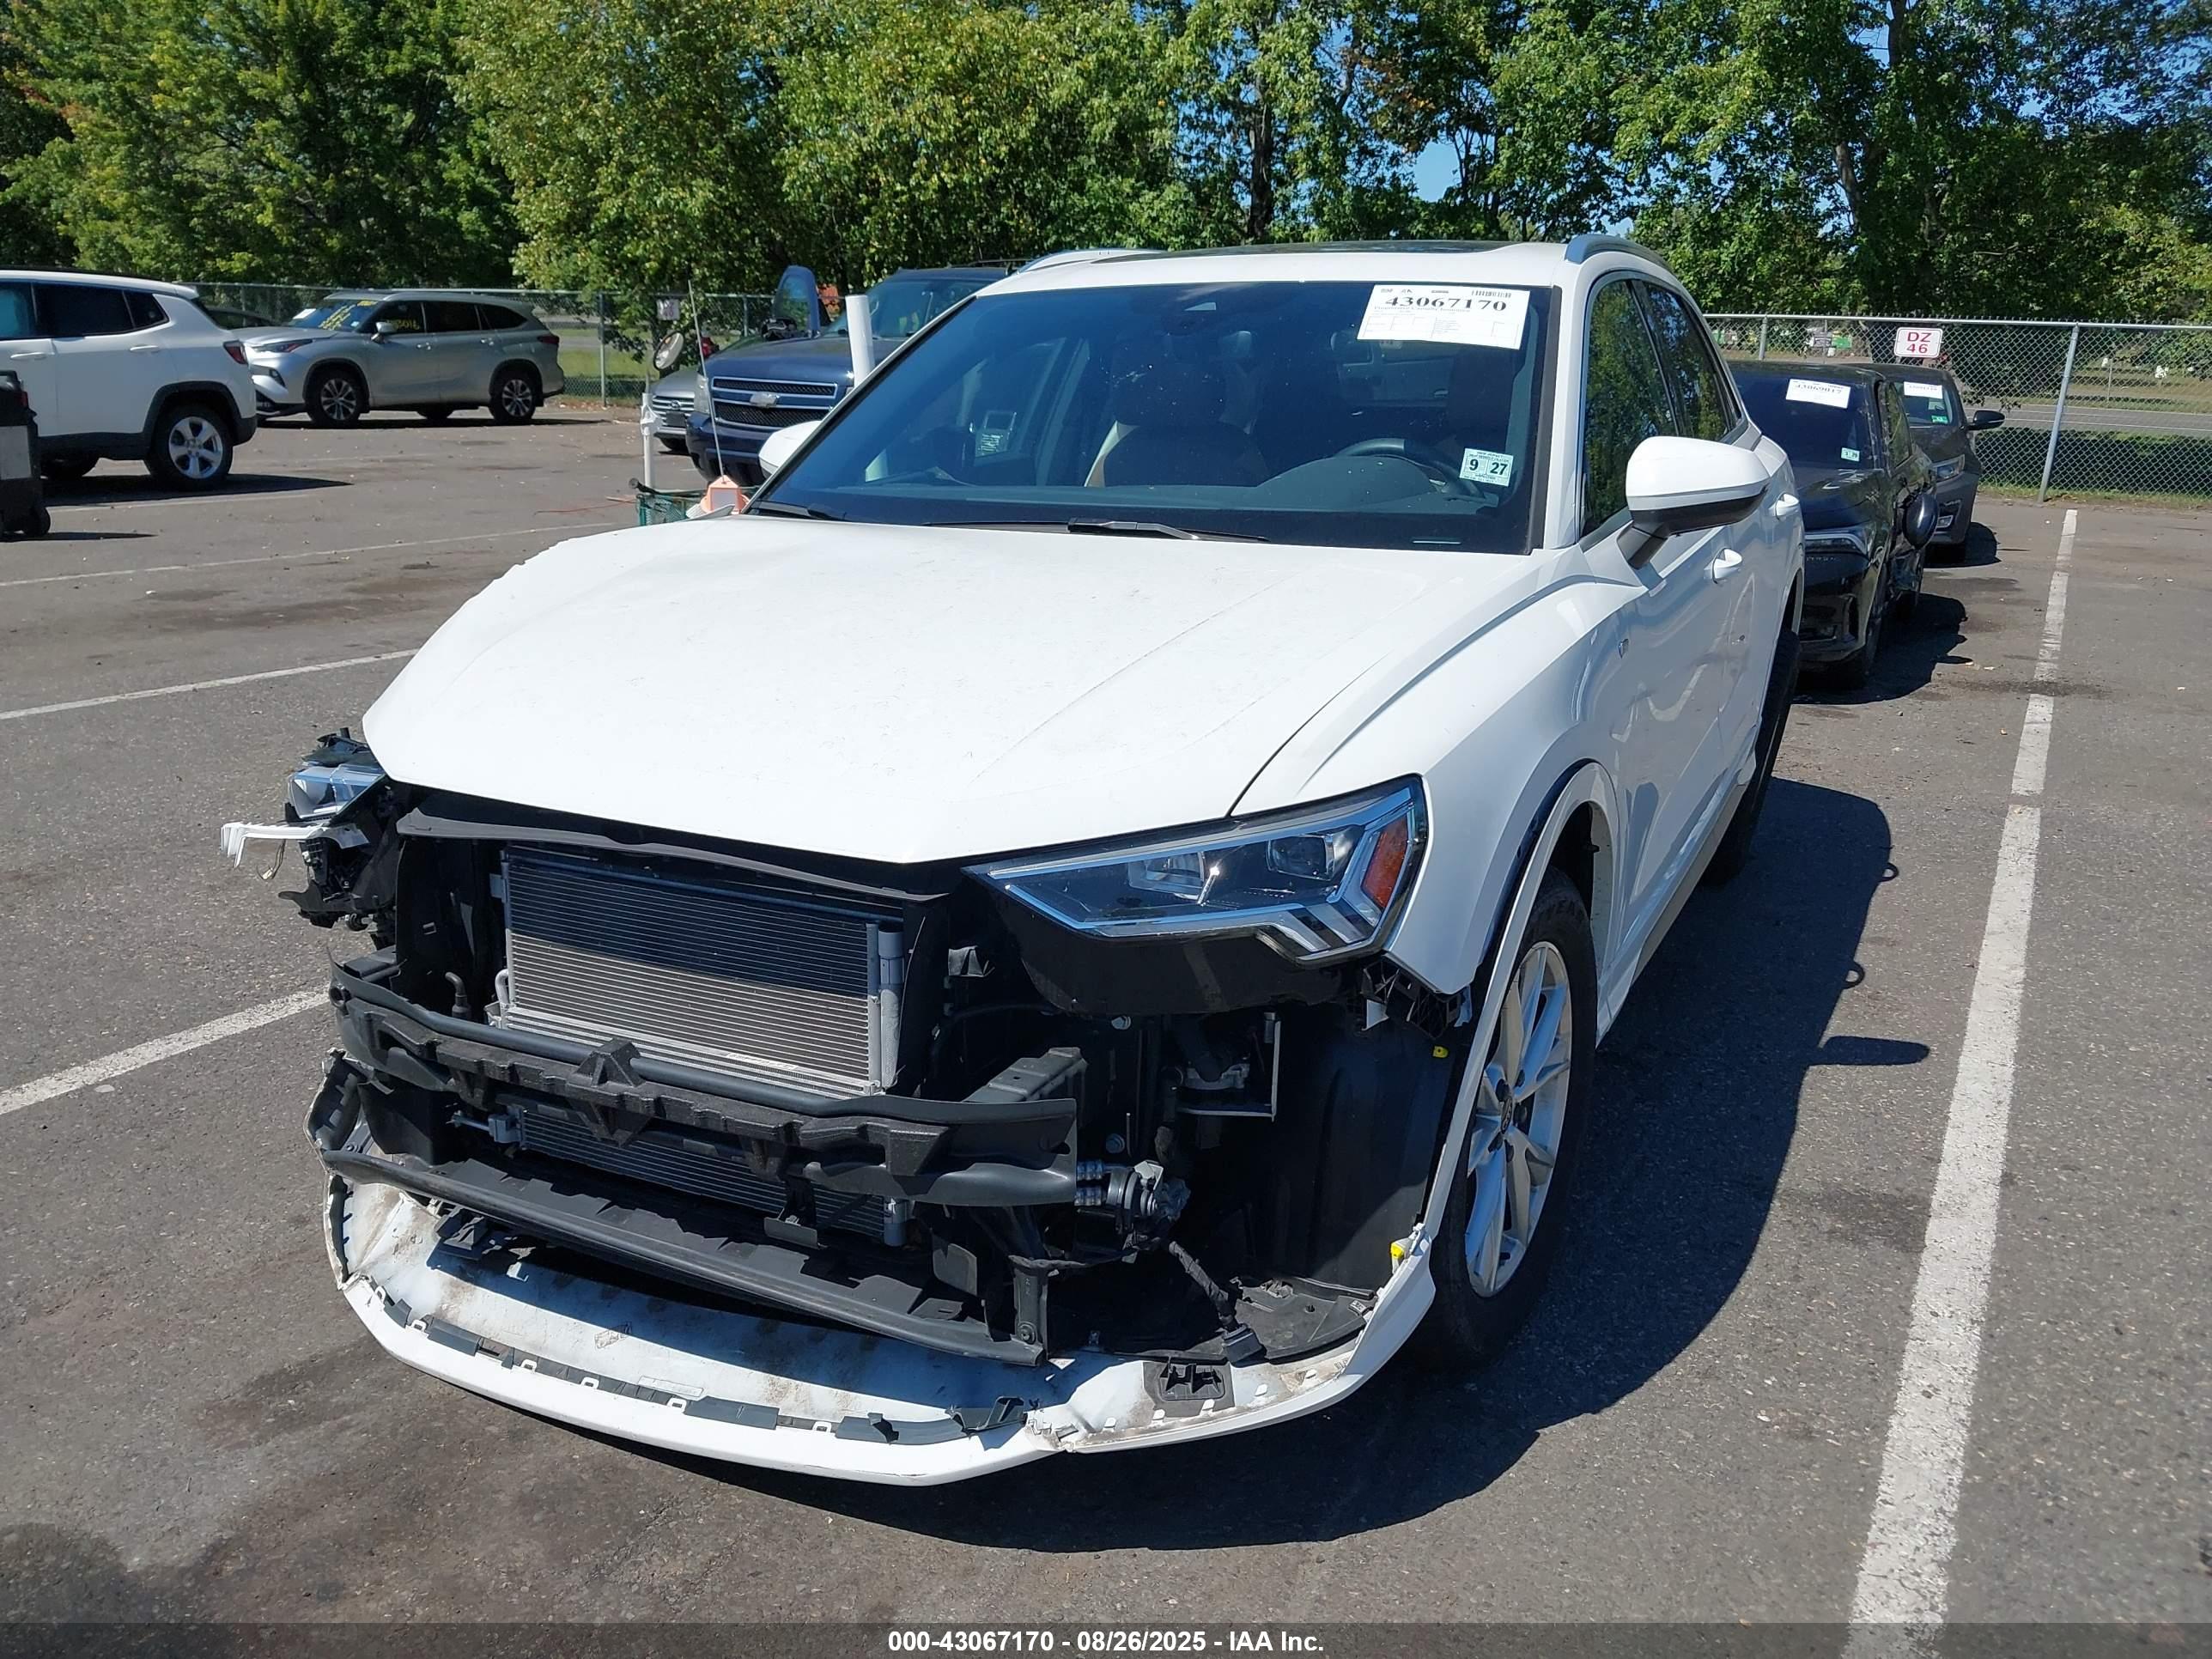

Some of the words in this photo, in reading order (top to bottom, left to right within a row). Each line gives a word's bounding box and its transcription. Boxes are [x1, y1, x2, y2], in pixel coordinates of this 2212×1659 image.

[1385, 296, 1507, 312] 43067170
[1907, 331, 1932, 343] DZ
[1906, 343, 1929, 354] 46
[1469, 459, 1479, 471] 9
[1490, 462, 1508, 475] 27
